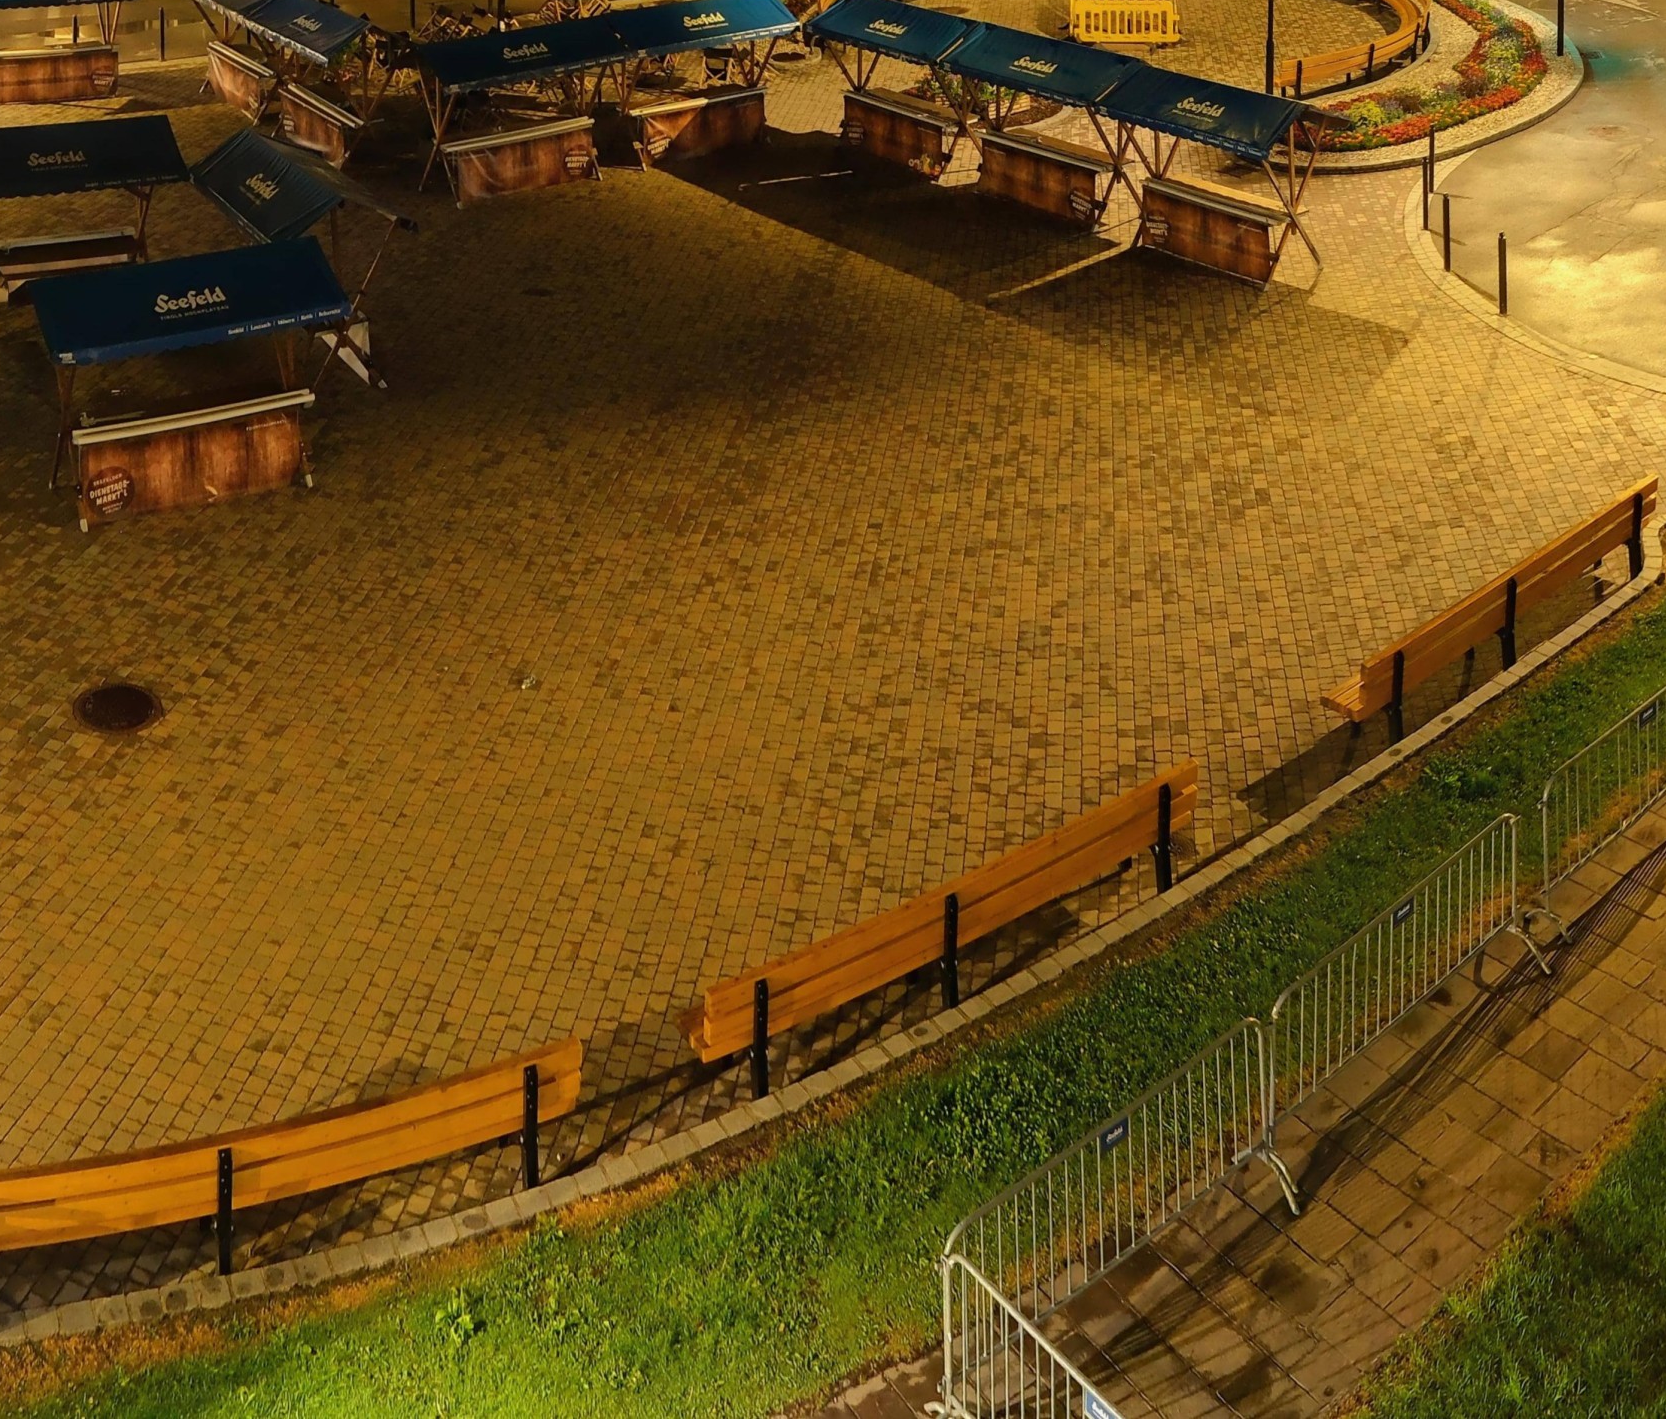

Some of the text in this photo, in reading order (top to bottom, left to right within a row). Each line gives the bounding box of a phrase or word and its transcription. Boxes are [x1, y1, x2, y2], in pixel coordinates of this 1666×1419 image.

[683, 11, 726, 28] Seefeld
[869, 19, 909, 35] Seefeld
[503, 42, 549, 59] Seefeld
[1013, 55, 1058, 74] Seefeld
[1177, 96, 1226, 118] Seefeld
[27, 149, 87, 168] Seefeld
[246, 172, 280, 201] Seefeld
[154, 286, 227, 313] Seefeld
[89, 480, 130, 499] DIENSTAGS-
